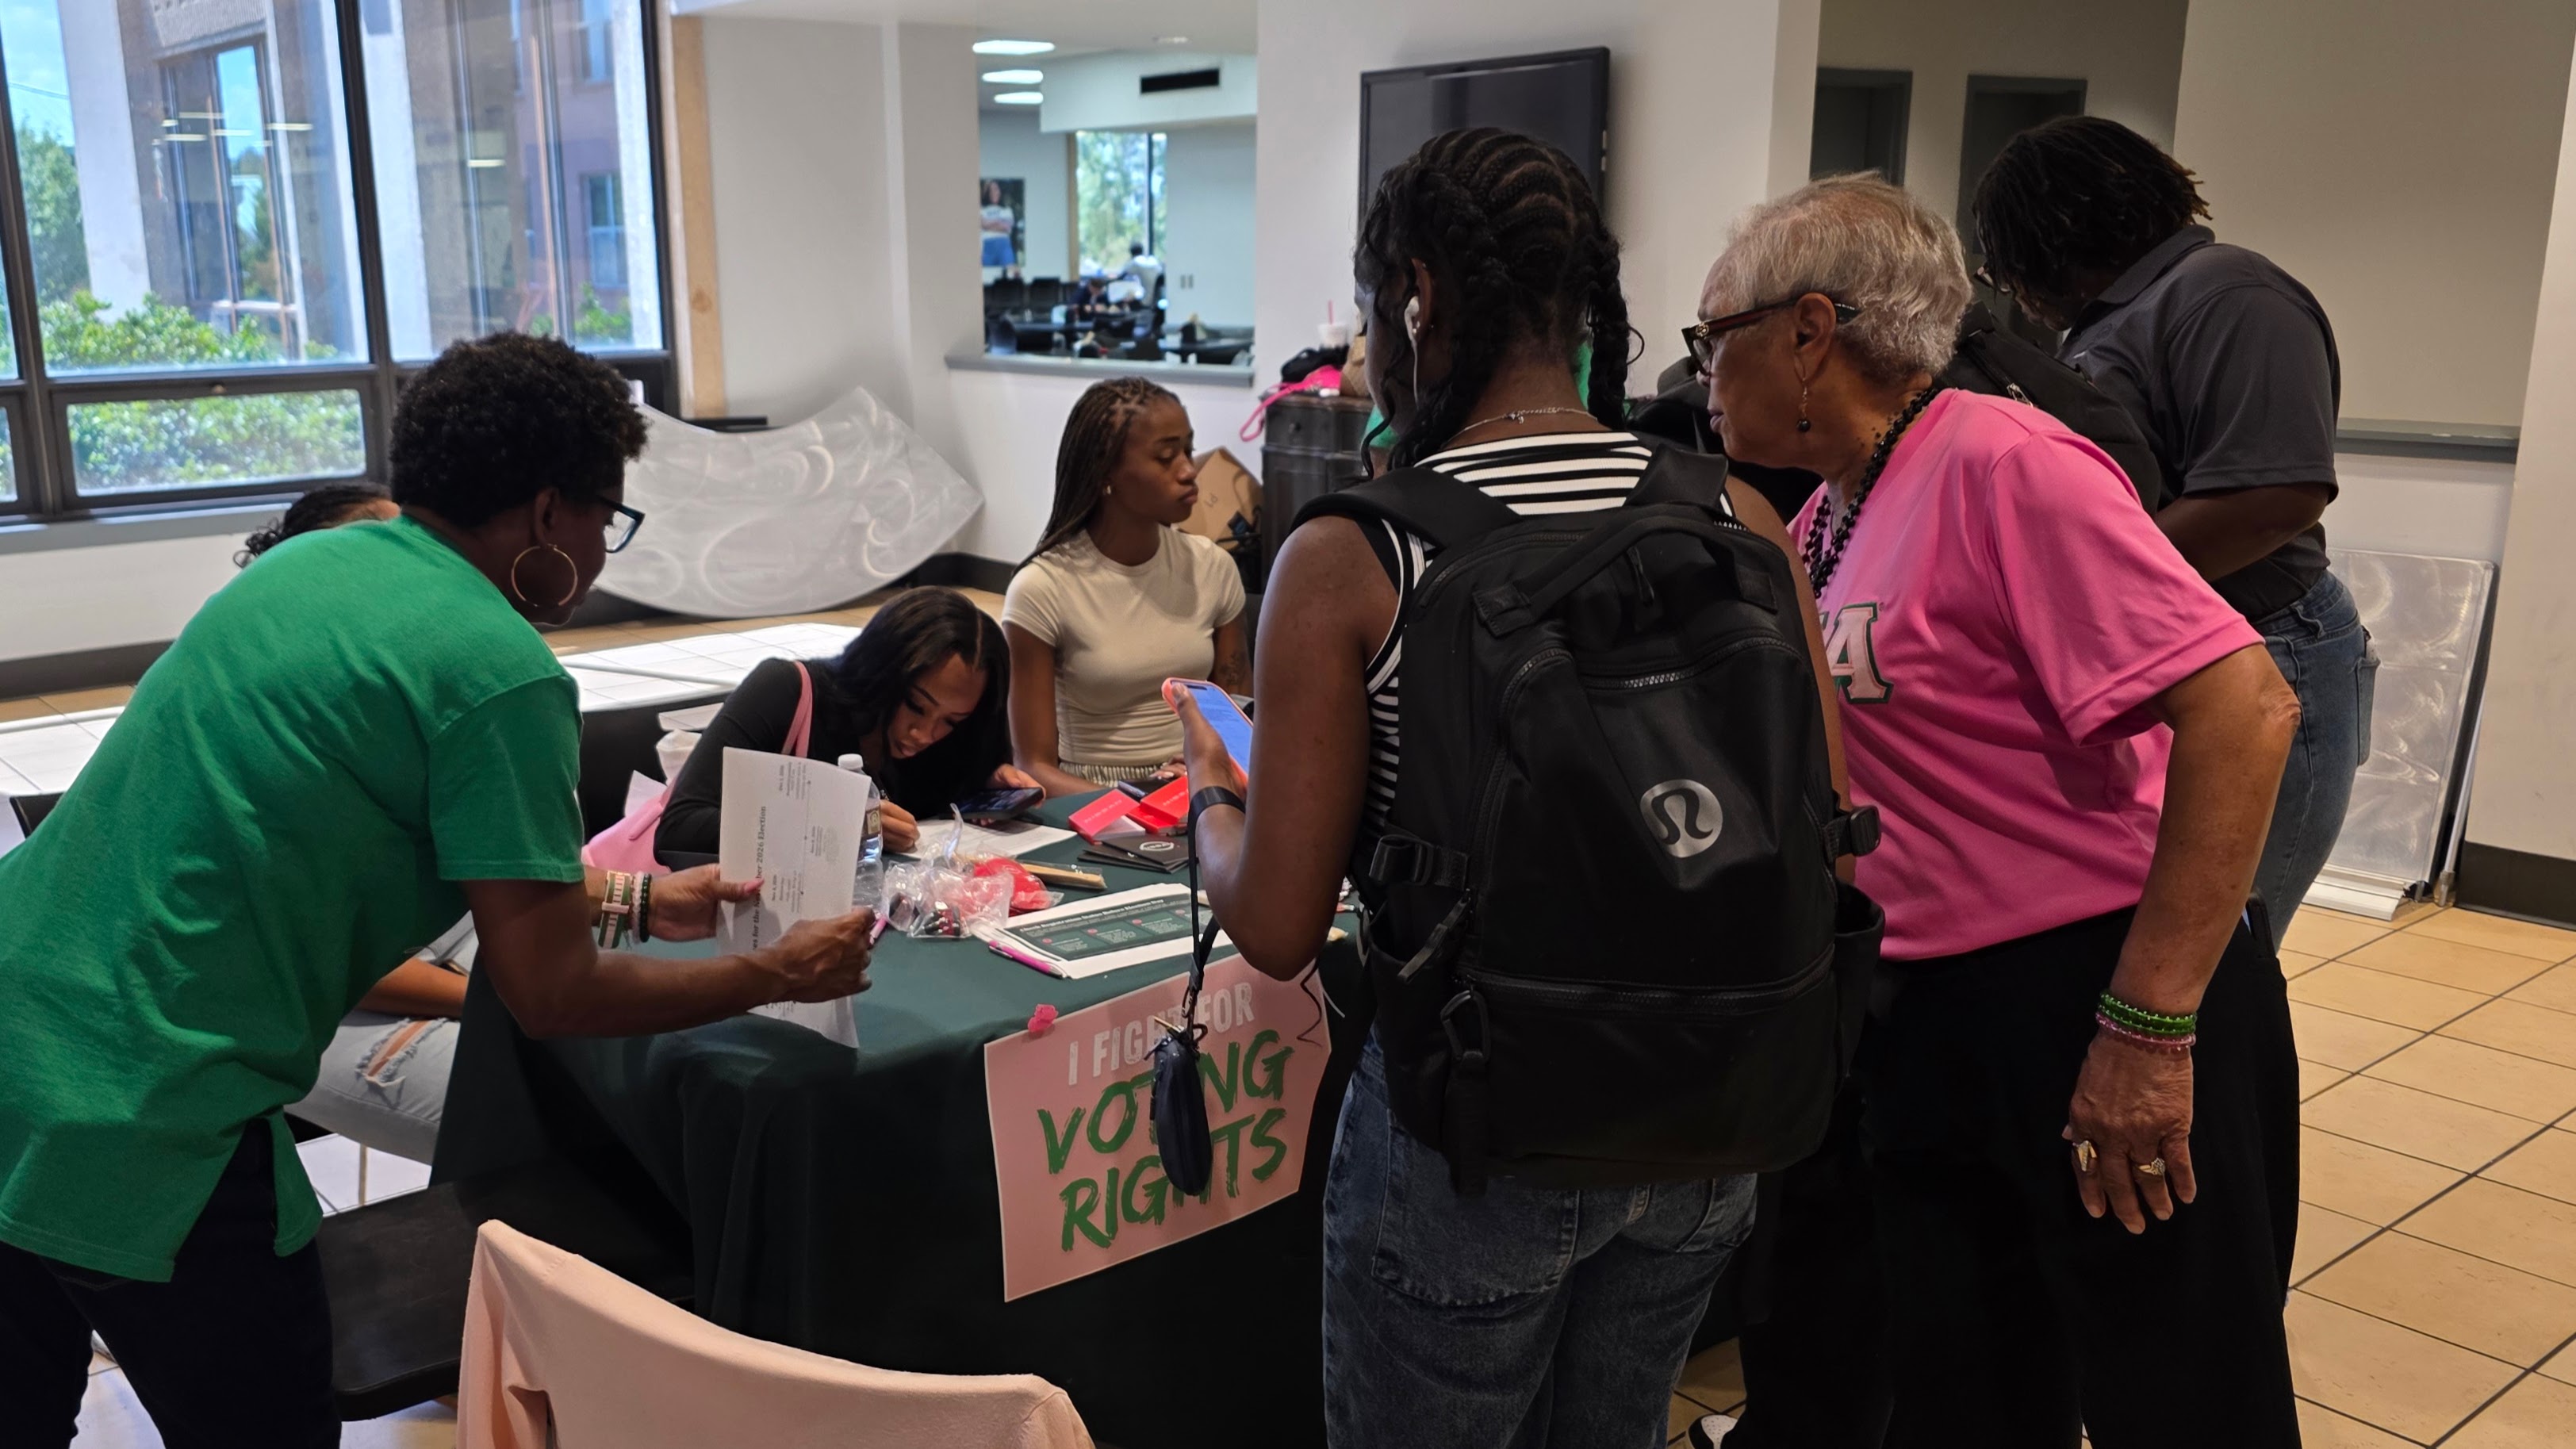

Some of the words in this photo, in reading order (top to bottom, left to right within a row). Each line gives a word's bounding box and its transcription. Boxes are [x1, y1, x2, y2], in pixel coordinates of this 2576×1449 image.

[756, 841, 765, 863] 2026
[757, 806, 766, 840] Election
[1068, 1041, 1079, 1086] I
[1195, 982, 1255, 1038] FOR
[1037, 1029, 1295, 1175] VONG
[1059, 1108, 1288, 1252] RIGTS
